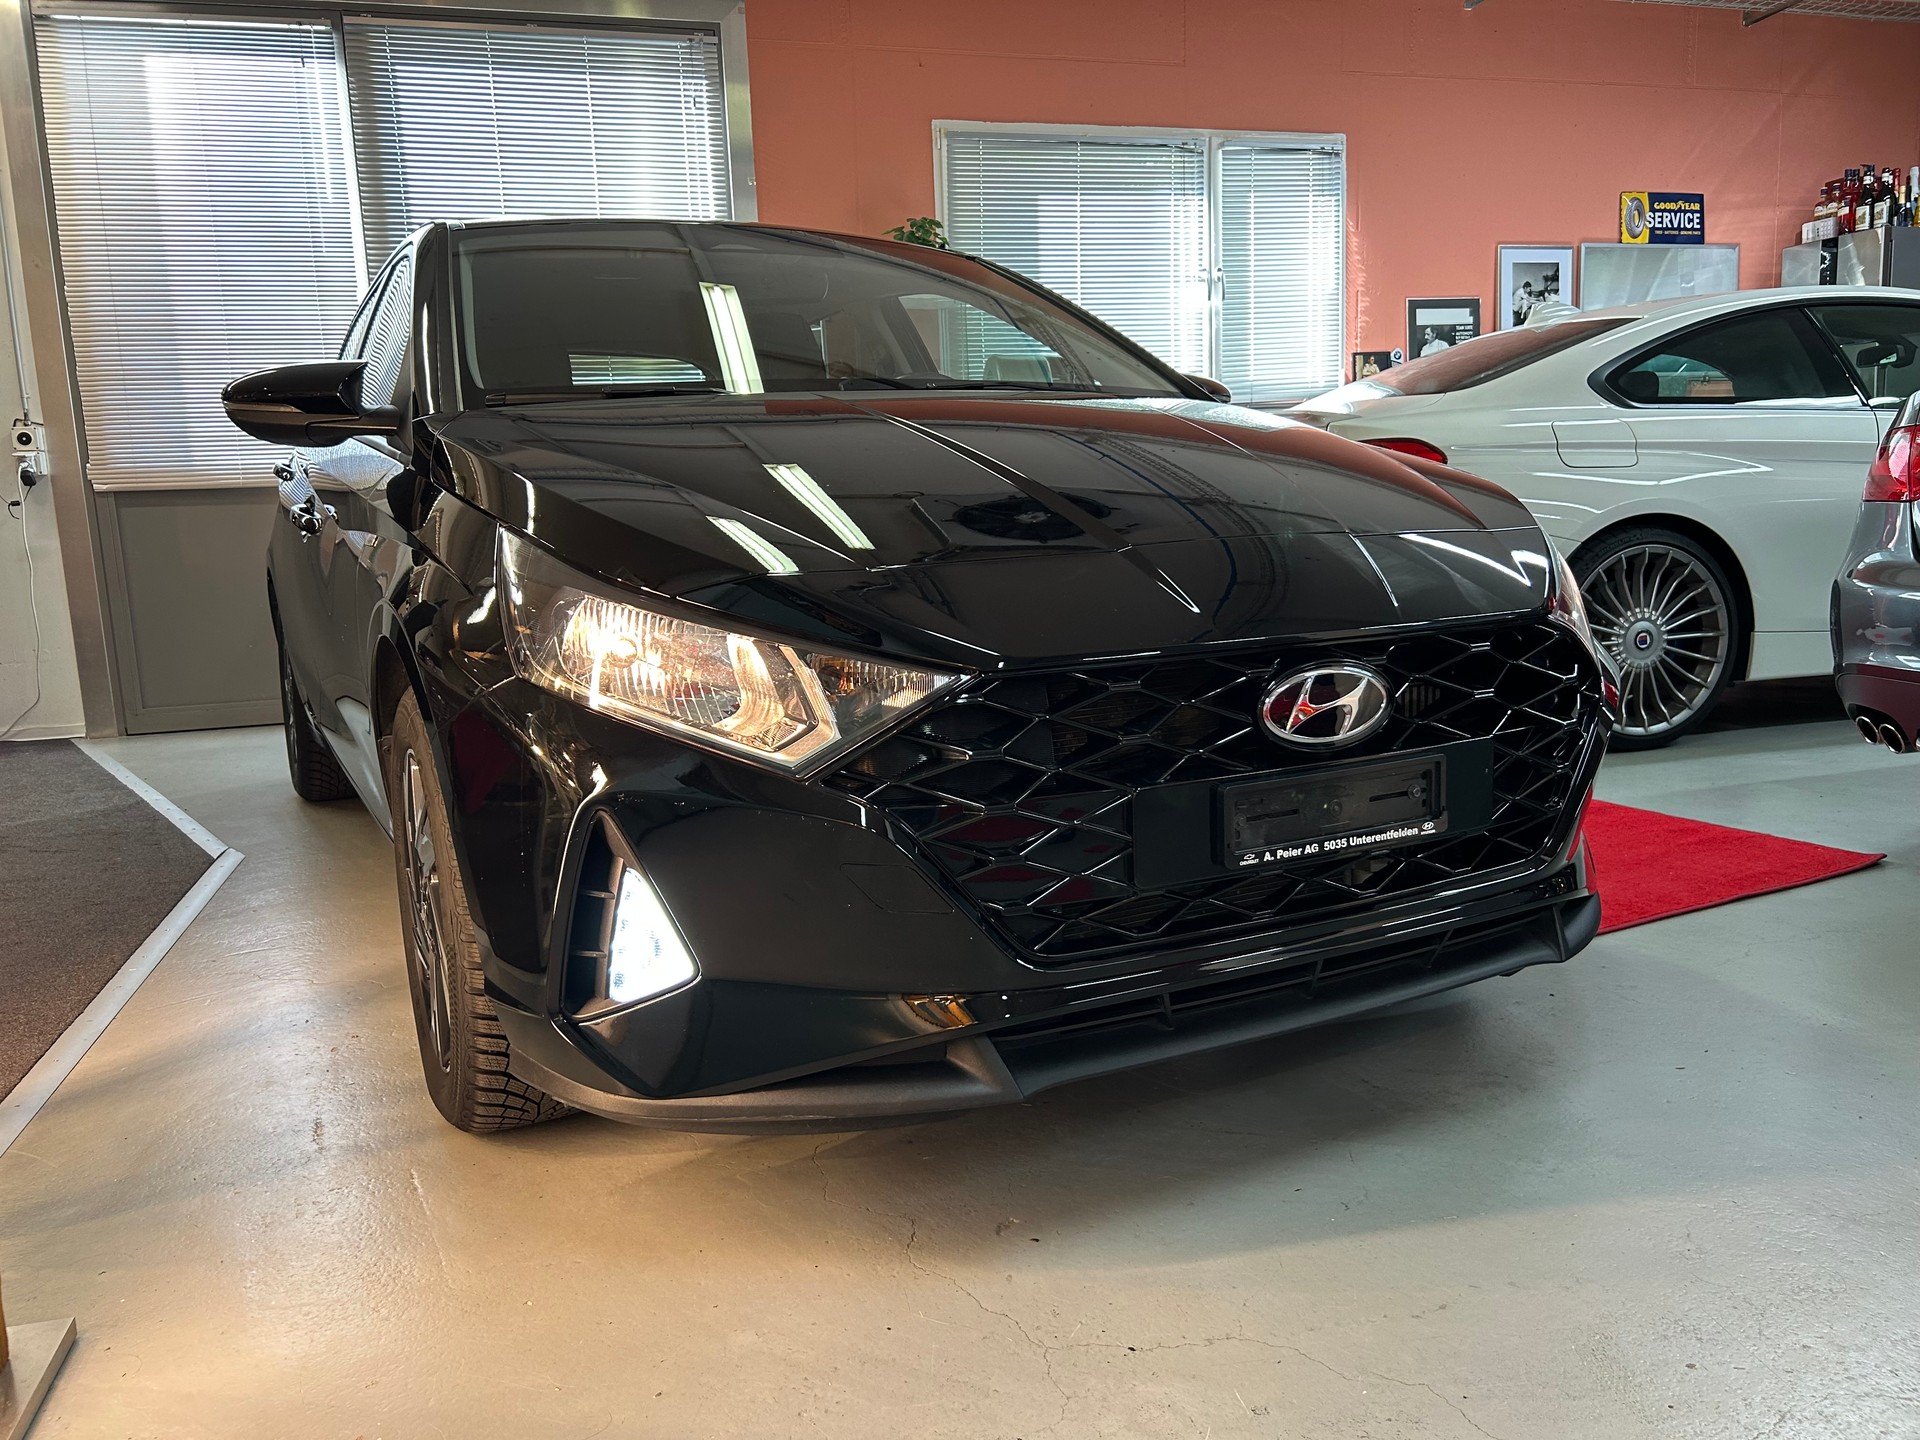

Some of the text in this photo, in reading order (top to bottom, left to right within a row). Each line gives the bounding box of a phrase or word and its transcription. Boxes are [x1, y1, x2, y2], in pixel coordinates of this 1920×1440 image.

[1654, 201, 1700, 210] GOODYEAR
[1645, 212, 1700, 228] SERVICE
[1263, 851, 1275, 862] A.
[1276, 847, 1303, 860] Peier
[1304, 843, 1319, 855] AG
[1323, 838, 1348, 851] 5035
[1349, 827, 1418, 845] Unterentfelden
